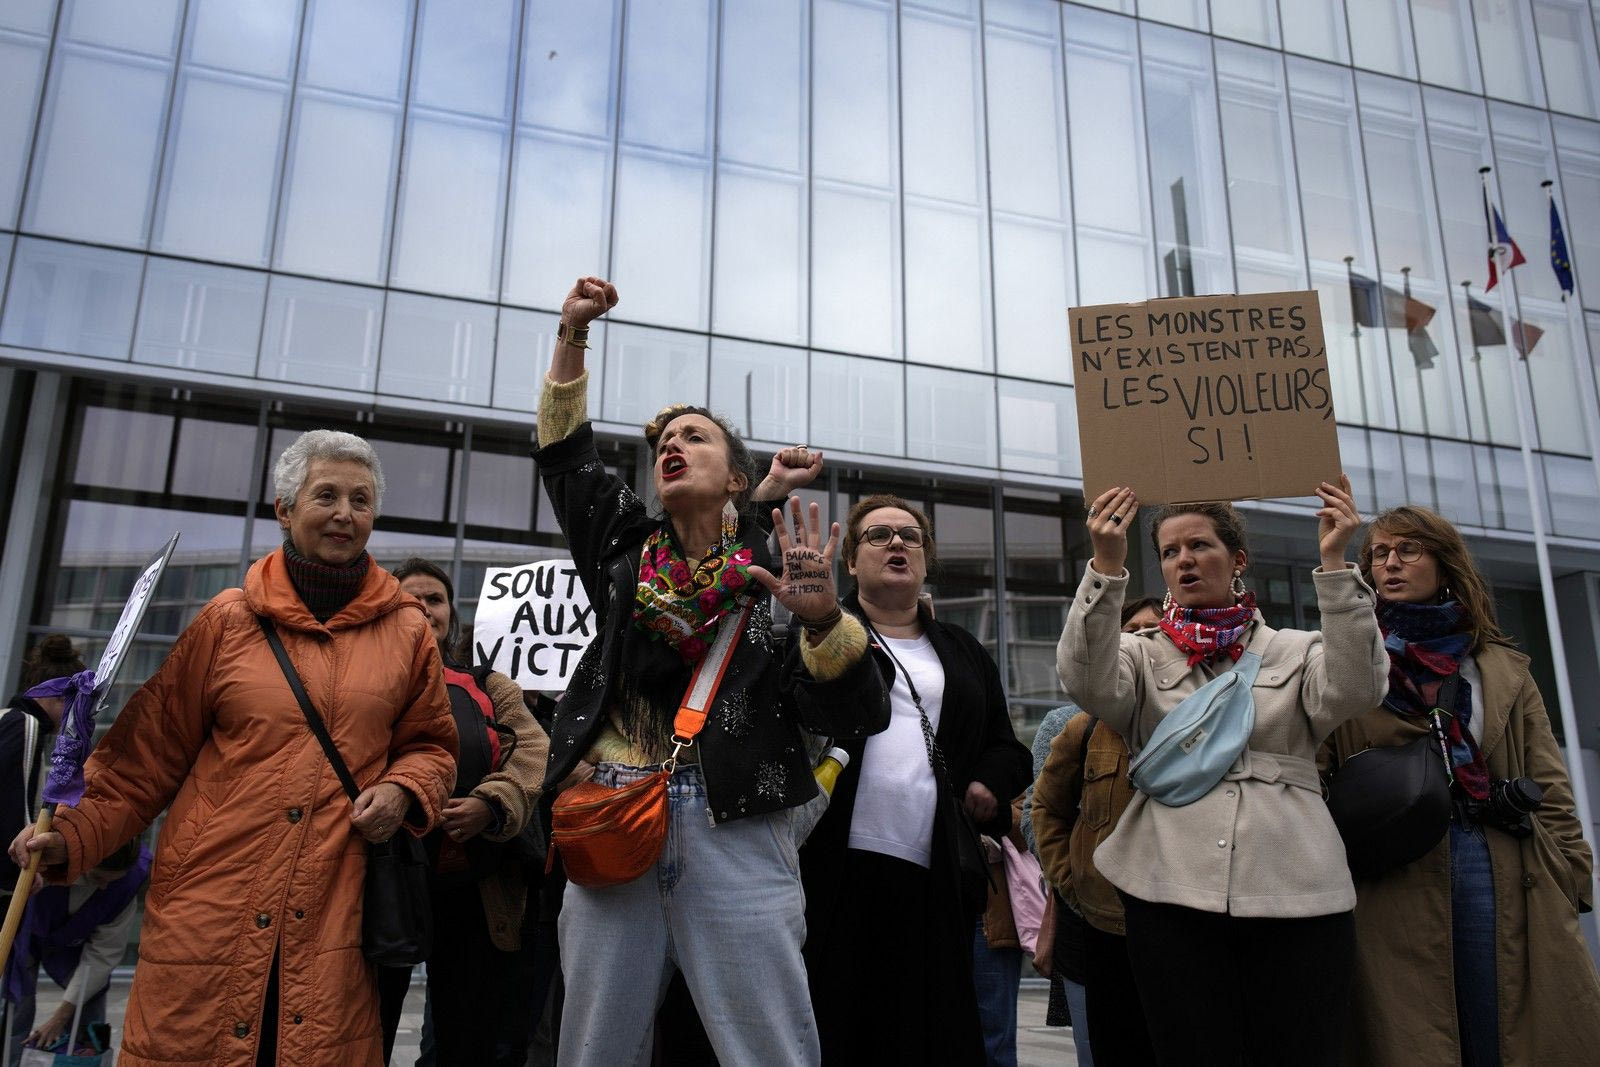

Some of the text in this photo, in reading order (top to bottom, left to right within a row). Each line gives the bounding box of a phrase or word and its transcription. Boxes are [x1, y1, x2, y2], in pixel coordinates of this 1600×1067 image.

[1077, 305, 1306, 344] LES MONSTRES
[1081, 335, 1324, 372] N'EXISTENT PAS,
[1103, 368, 1333, 420] LES VIOLEURS,
[1187, 423, 1253, 465] SI !
[785, 551, 825, 565] BALANCE
[785, 562, 802, 574] TON
[510, 601, 593, 637] AUX
